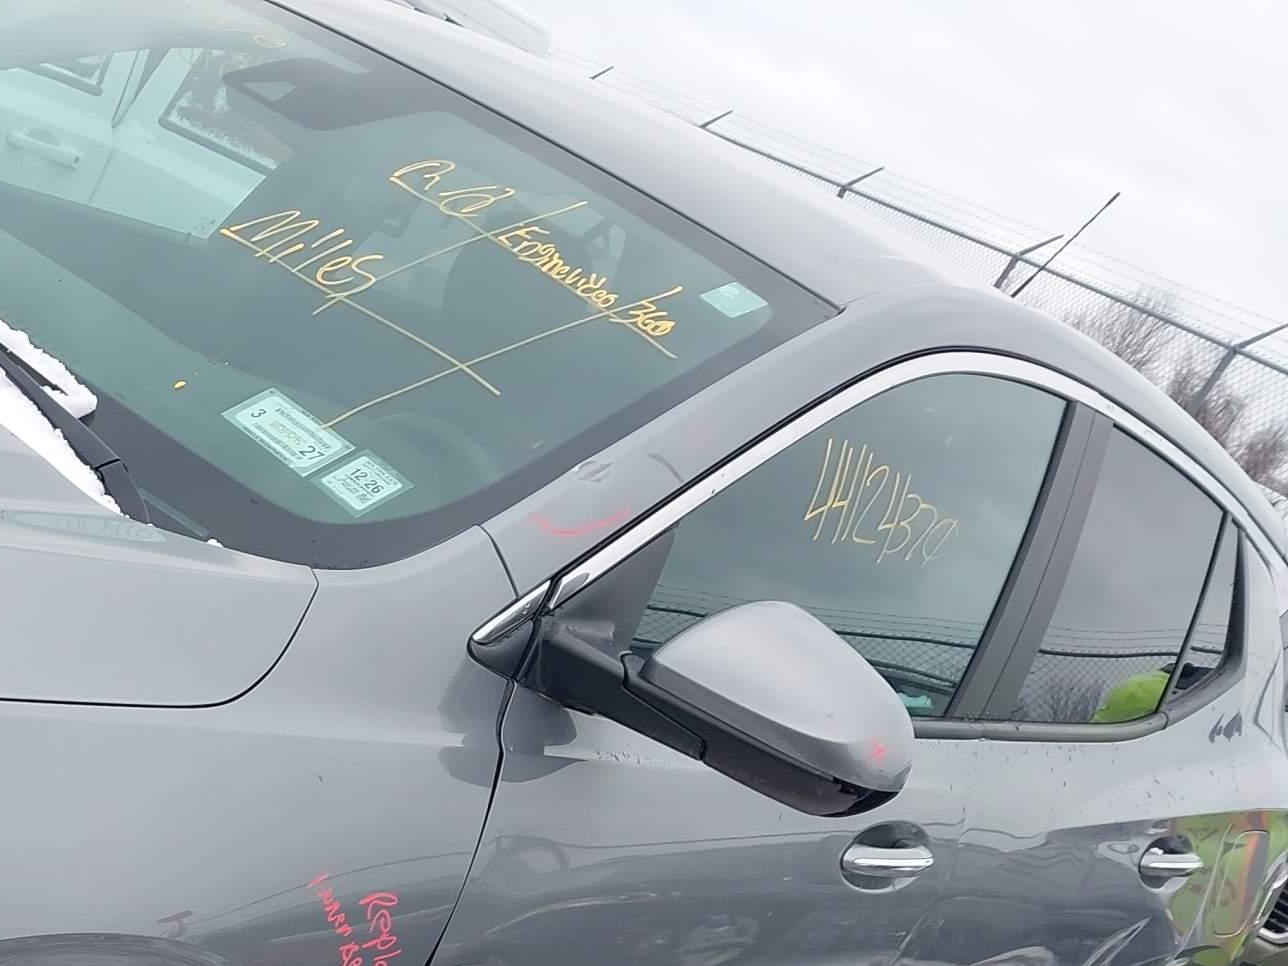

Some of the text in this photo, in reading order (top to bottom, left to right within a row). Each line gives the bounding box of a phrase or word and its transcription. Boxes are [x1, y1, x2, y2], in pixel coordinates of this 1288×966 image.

[225, 209, 385, 299] Miles
[250, 408, 325, 461] 3 27
